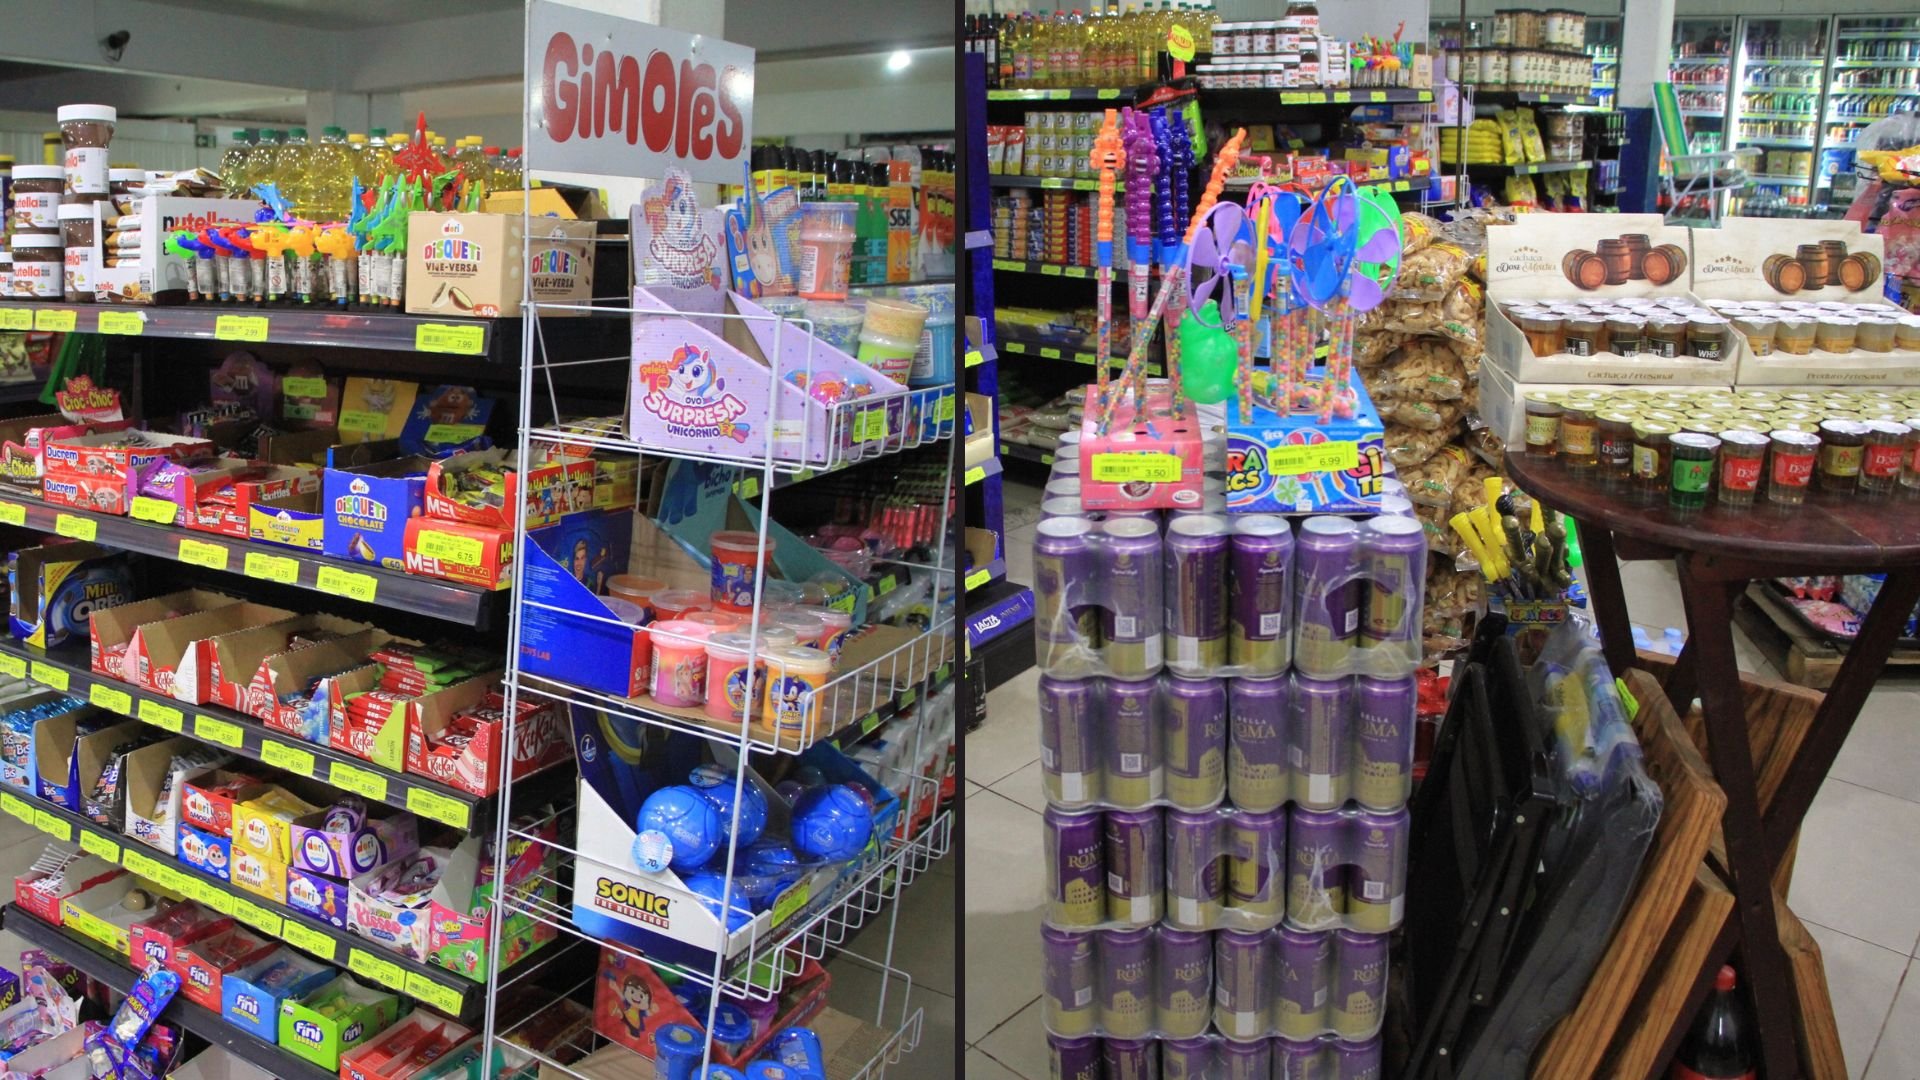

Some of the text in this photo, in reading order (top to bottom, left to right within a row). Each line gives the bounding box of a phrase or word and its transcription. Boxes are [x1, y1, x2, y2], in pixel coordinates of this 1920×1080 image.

[444, 223, 460, 233] dori
[244, 326, 258, 336] 2.99
[456, 340, 473, 349] 7.99
[643, 389, 746, 428] SURPRESA
[685, 396, 702, 405] OVO
[47, 446, 78, 461] Ducrem
[1227, 448, 1264, 472] RA
[1319, 456, 1341, 466] 6.99
[1144, 469, 1167, 477] 3.50
[45, 479, 77, 495] Ducrem
[262, 487, 291, 501] Skittles
[198, 515, 220, 525] Skittles
[338, 514, 385, 530] CHOCOLATE
[406, 551, 446, 576] MEL
[457, 551, 473, 562] 6.75
[351, 586, 365, 596] 8.99
[72, 593, 125, 622] OREO
[516, 710, 557, 760] KitKat
[430, 757, 455, 776] KitKat
[188, 798, 209, 813] dori
[249, 820, 265, 836] dori
[185, 840, 204, 856] dori
[307, 839, 325, 853] dori
[356, 836, 374, 853] dori
[239, 864, 261, 877] dori
[236, 875, 262, 889] BANANA
[293, 883, 315, 902] dori
[596, 876, 671, 919] SONIC
[616, 902, 670, 929] HEDGEHOG
[144, 941, 168, 961] Fini
[189, 966, 210, 986] Fini
[379, 971, 394, 983] 2.99
[236, 993, 259, 1016] Fini
[295, 1021, 321, 1042] Fini
